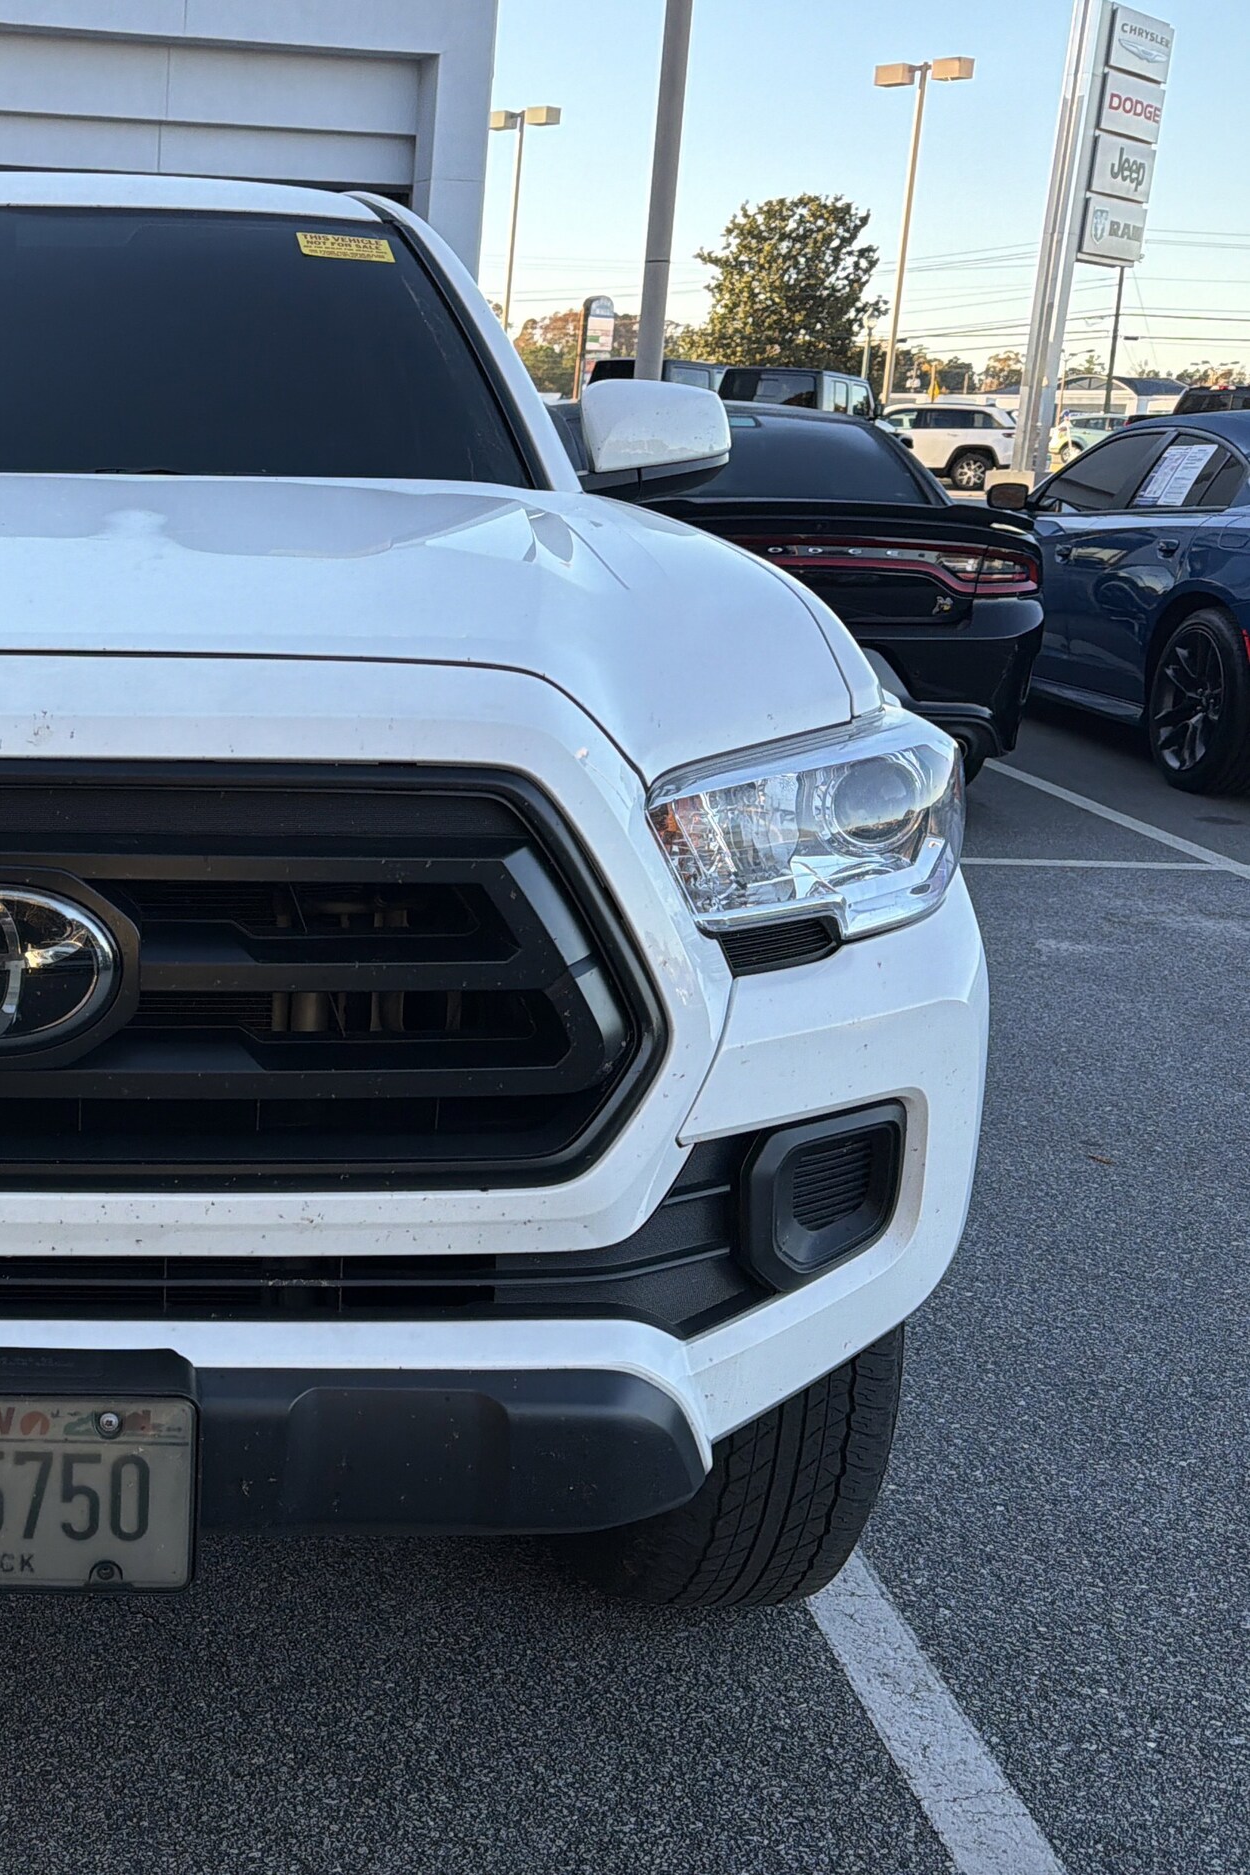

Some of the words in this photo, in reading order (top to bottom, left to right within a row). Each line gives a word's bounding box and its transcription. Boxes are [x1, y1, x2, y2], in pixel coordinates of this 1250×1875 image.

[1121, 22, 1170, 48] CHRYSLER
[1108, 92, 1161, 124] DODGE
[1110, 147, 1146, 192] Jeep
[331, 236, 383, 246] VEHICLE
[1108, 219, 1143, 243] RAM
